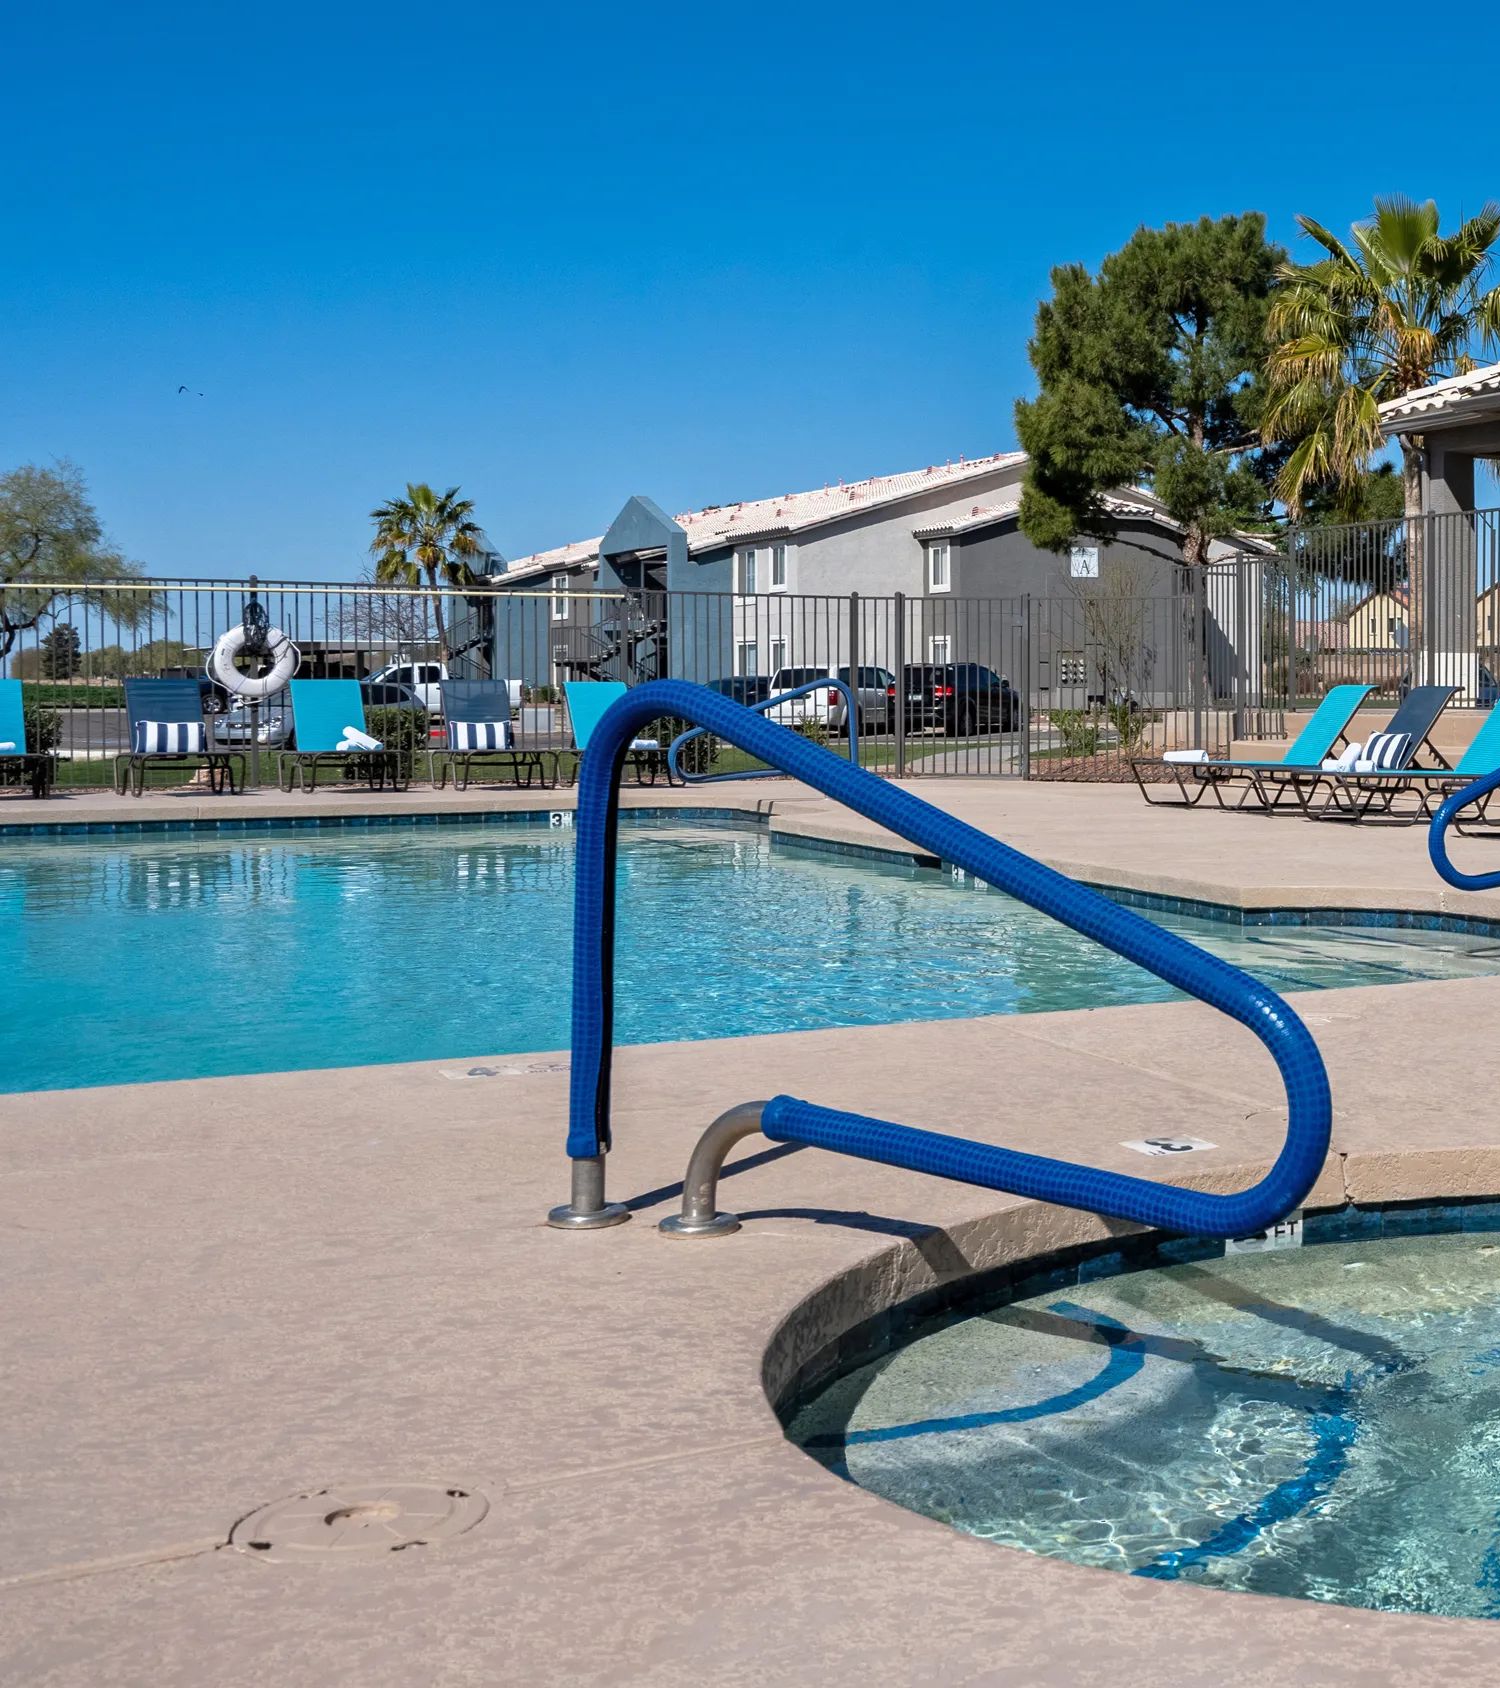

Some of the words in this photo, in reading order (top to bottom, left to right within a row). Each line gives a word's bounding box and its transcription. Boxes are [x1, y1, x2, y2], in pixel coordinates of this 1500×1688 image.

[1079, 559, 1090, 575] A
[552, 813, 562, 827] 3
[1274, 1221, 1299, 1238] FT
